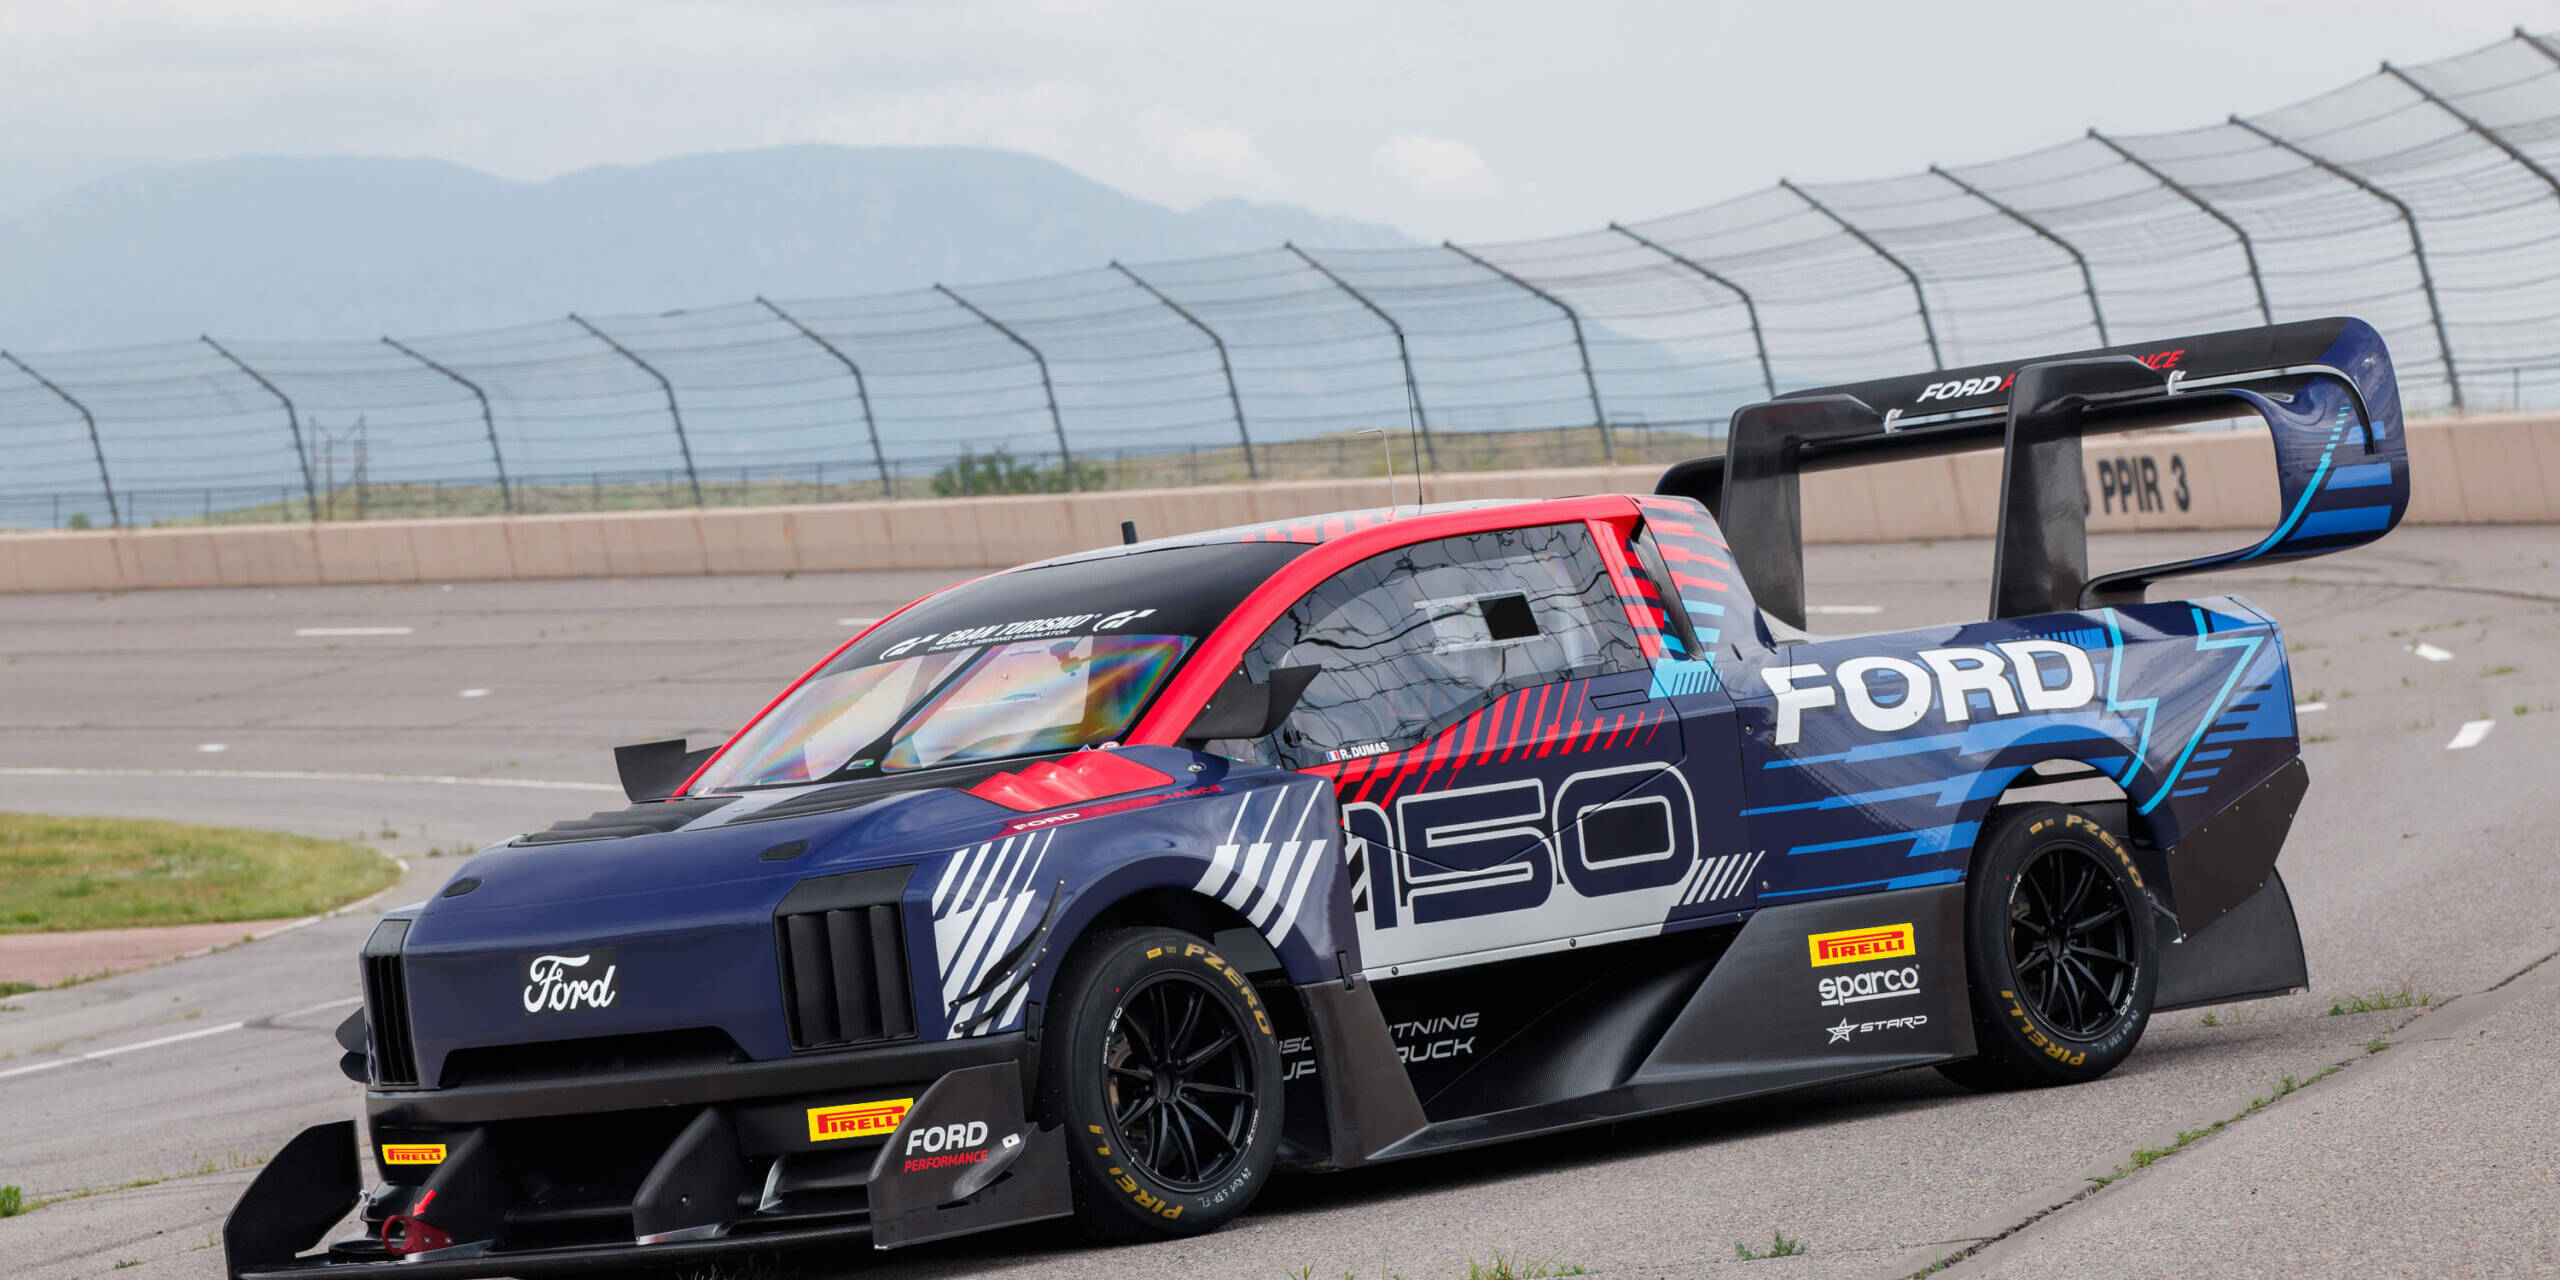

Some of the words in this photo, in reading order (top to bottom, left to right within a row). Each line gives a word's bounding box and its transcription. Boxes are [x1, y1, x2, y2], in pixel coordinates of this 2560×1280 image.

[1916, 375, 2002, 403] FORD
[2097, 456, 2165, 515] PPIR
[2171, 454, 2191, 513] 3
[927, 643, 946, 652] THE
[945, 639, 970, 649] REAL
[971, 635, 1011, 646] DRIVING
[1012, 629, 1071, 641] SIMULATOR
[936, 624, 1003, 645] GRAN
[996, 614, 1094, 637] TURISMO
[1760, 639, 2096, 746] FORD
[1340, 748, 1352, 760] R.
[1351, 741, 1389, 758] DUMAS
[1014, 812, 1081, 831] FORD
[1818, 930, 1905, 960] PIRELLI
[523, 954, 616, 1013] Ford
[1818, 966, 1920, 1006] sparco
[1388, 1012, 1480, 1038] TNING
[1859, 1014, 1928, 1033] STARD
[2001, 990, 2086, 1065] PIRELLI
[817, 1105, 905, 1134] PIRELLI
[906, 1121, 988, 1156] FORD
[388, 1148, 441, 1161] PIRELLI
[904, 1150, 988, 1173] PERFORMANCE
